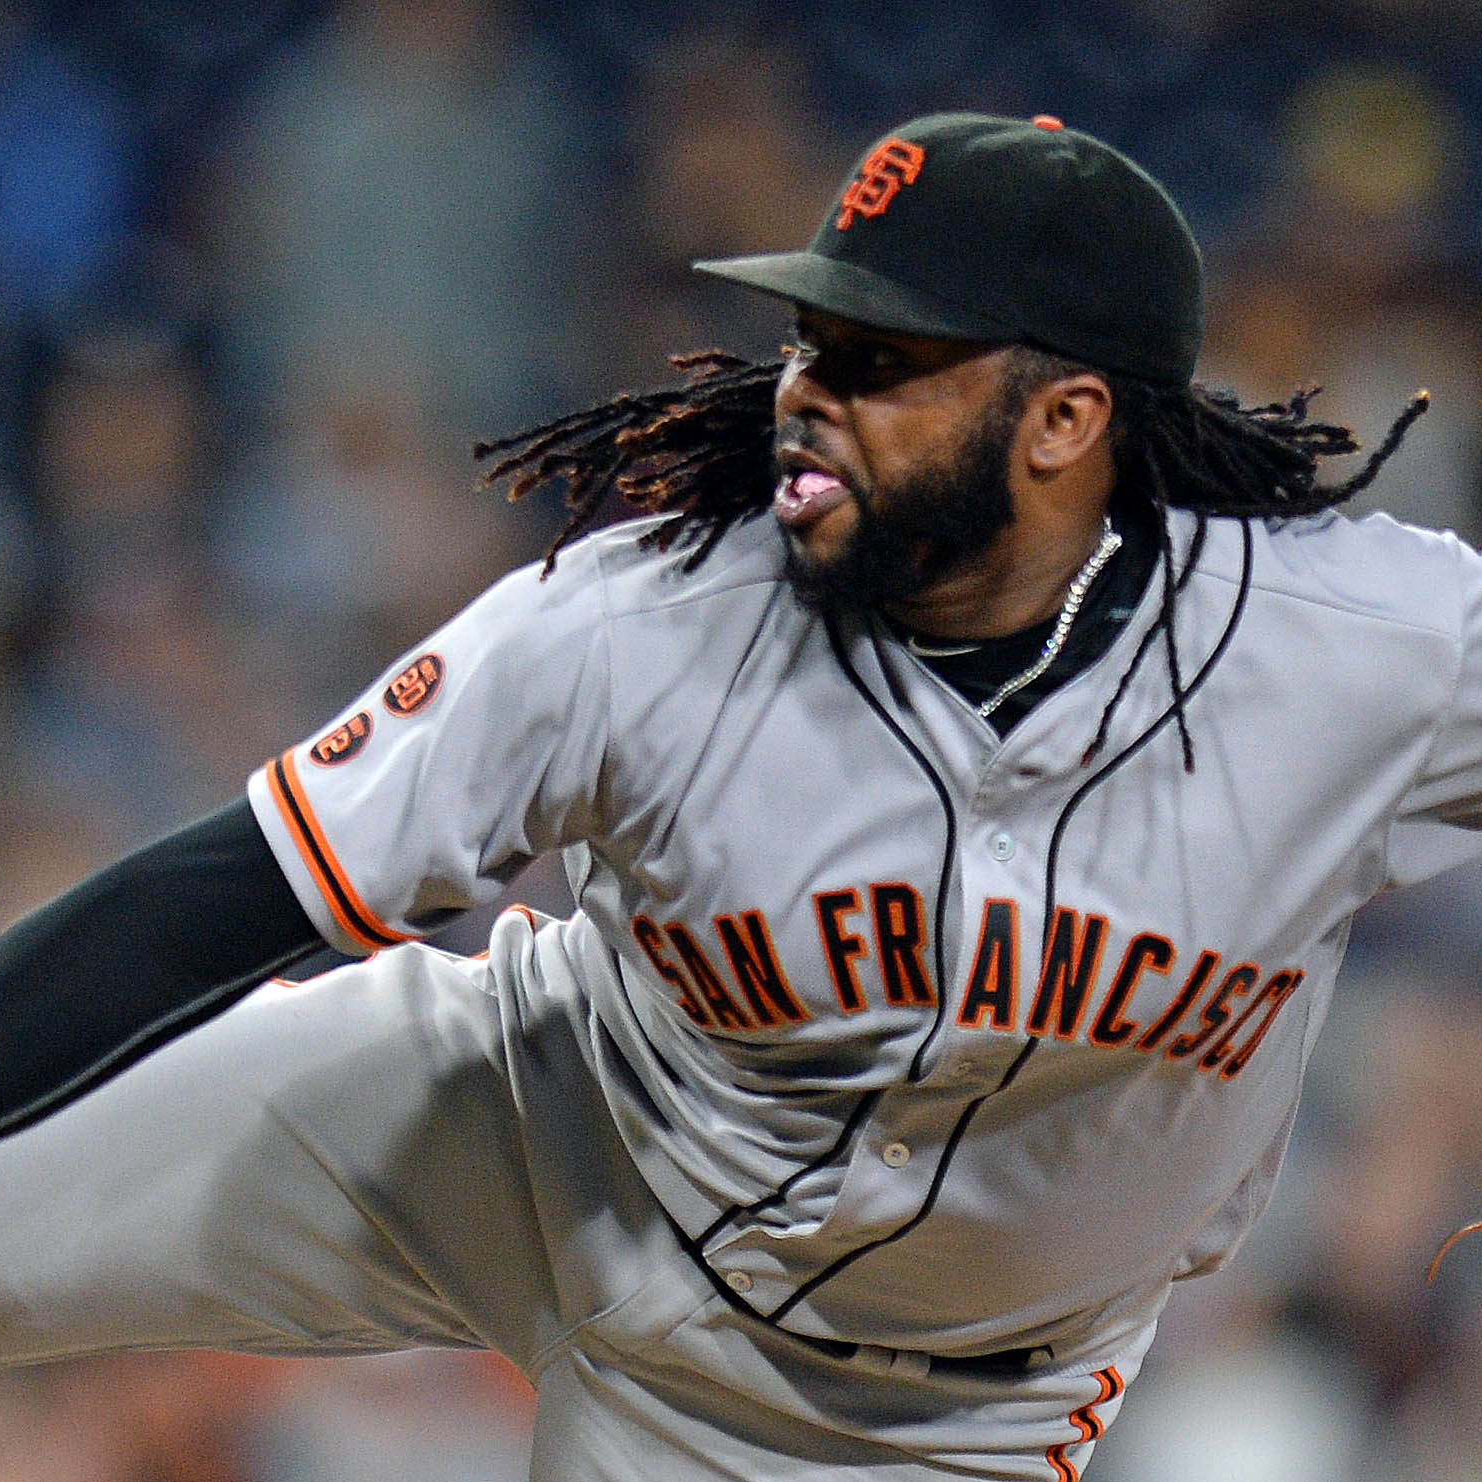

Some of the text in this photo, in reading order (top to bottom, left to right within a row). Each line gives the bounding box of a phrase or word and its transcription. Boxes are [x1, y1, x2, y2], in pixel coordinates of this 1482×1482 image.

[835, 137, 926, 231] SF
[390, 666, 428, 710] 20
[631, 881, 1306, 1081] SAN FRANCISCO
